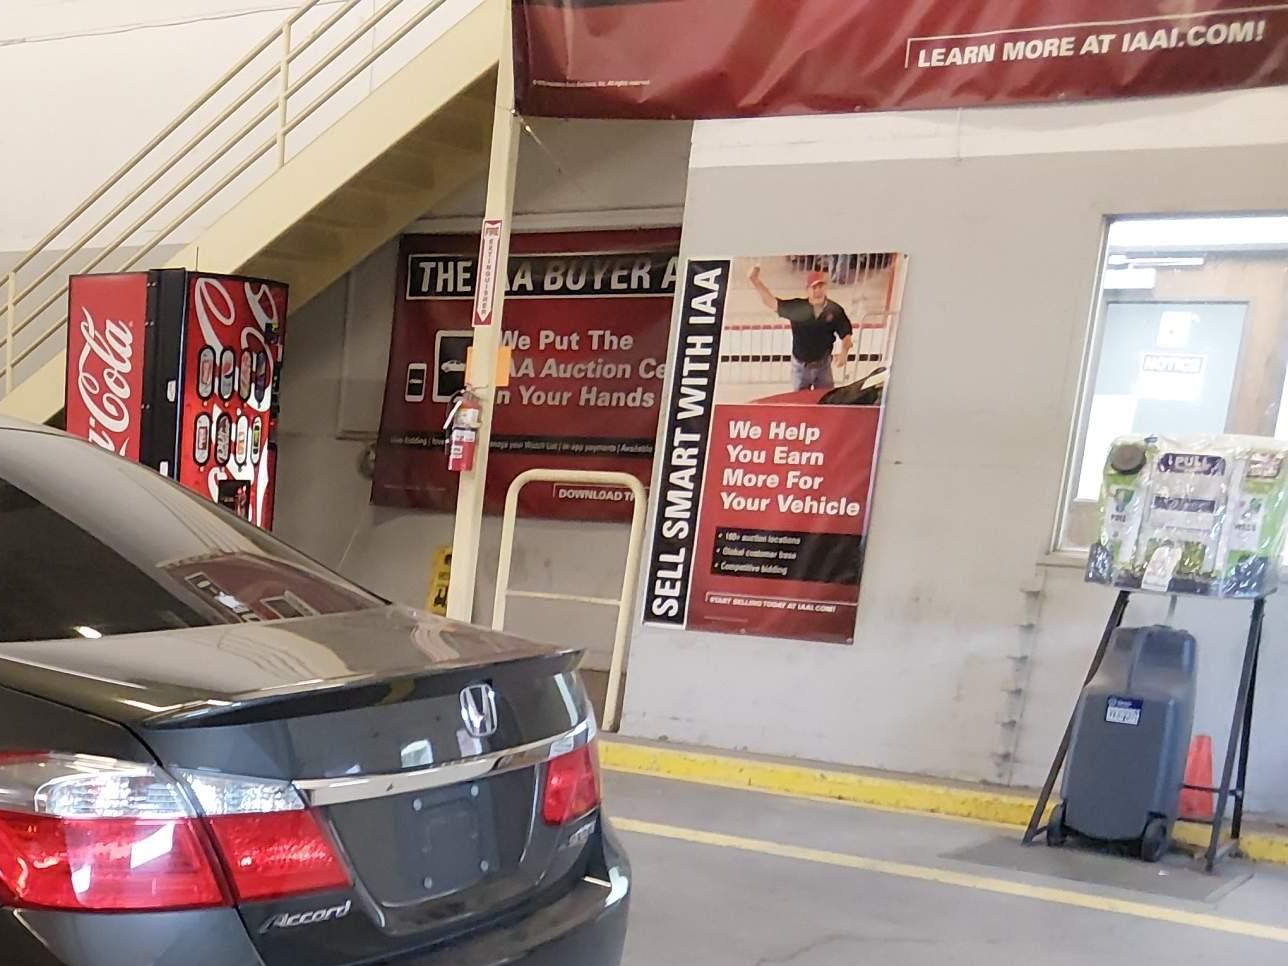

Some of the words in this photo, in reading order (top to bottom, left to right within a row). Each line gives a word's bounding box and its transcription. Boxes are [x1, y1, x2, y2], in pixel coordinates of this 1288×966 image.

[917, 43, 995, 68] LEARN
[1002, 37, 1075, 62] MORE
[1080, 34, 1116, 56] AT
[1121, 20, 1267, 53] IAAI.COM!
[418, 260, 473, 293] THE
[543, 257, 652, 292] BUYER
[688, 266, 722, 324] IAA
[501, 330, 531, 350] We
[539, 330, 579, 351] Put
[588, 330, 634, 350] The
[539, 358, 636, 378] Auction
[677, 334, 713, 420] WITH
[496, 388, 510, 405] n
[518, 385, 573, 406] Your
[579, 386, 655, 408] Hands
[728, 420, 762, 440] We
[769, 421, 821, 445] Help
[726, 444, 766, 464] You
[773, 446, 824, 466] Earn
[662, 427, 701, 540] SMART
[722, 468, 780, 488] More
[786, 470, 824, 490] For
[559, 489, 623, 501] DOWNLOAD
[720, 491, 770, 511] Your
[777, 493, 860, 516] Vehicle
[652, 547, 686, 618] SELL
[258, 899, 352, 934] Accord
